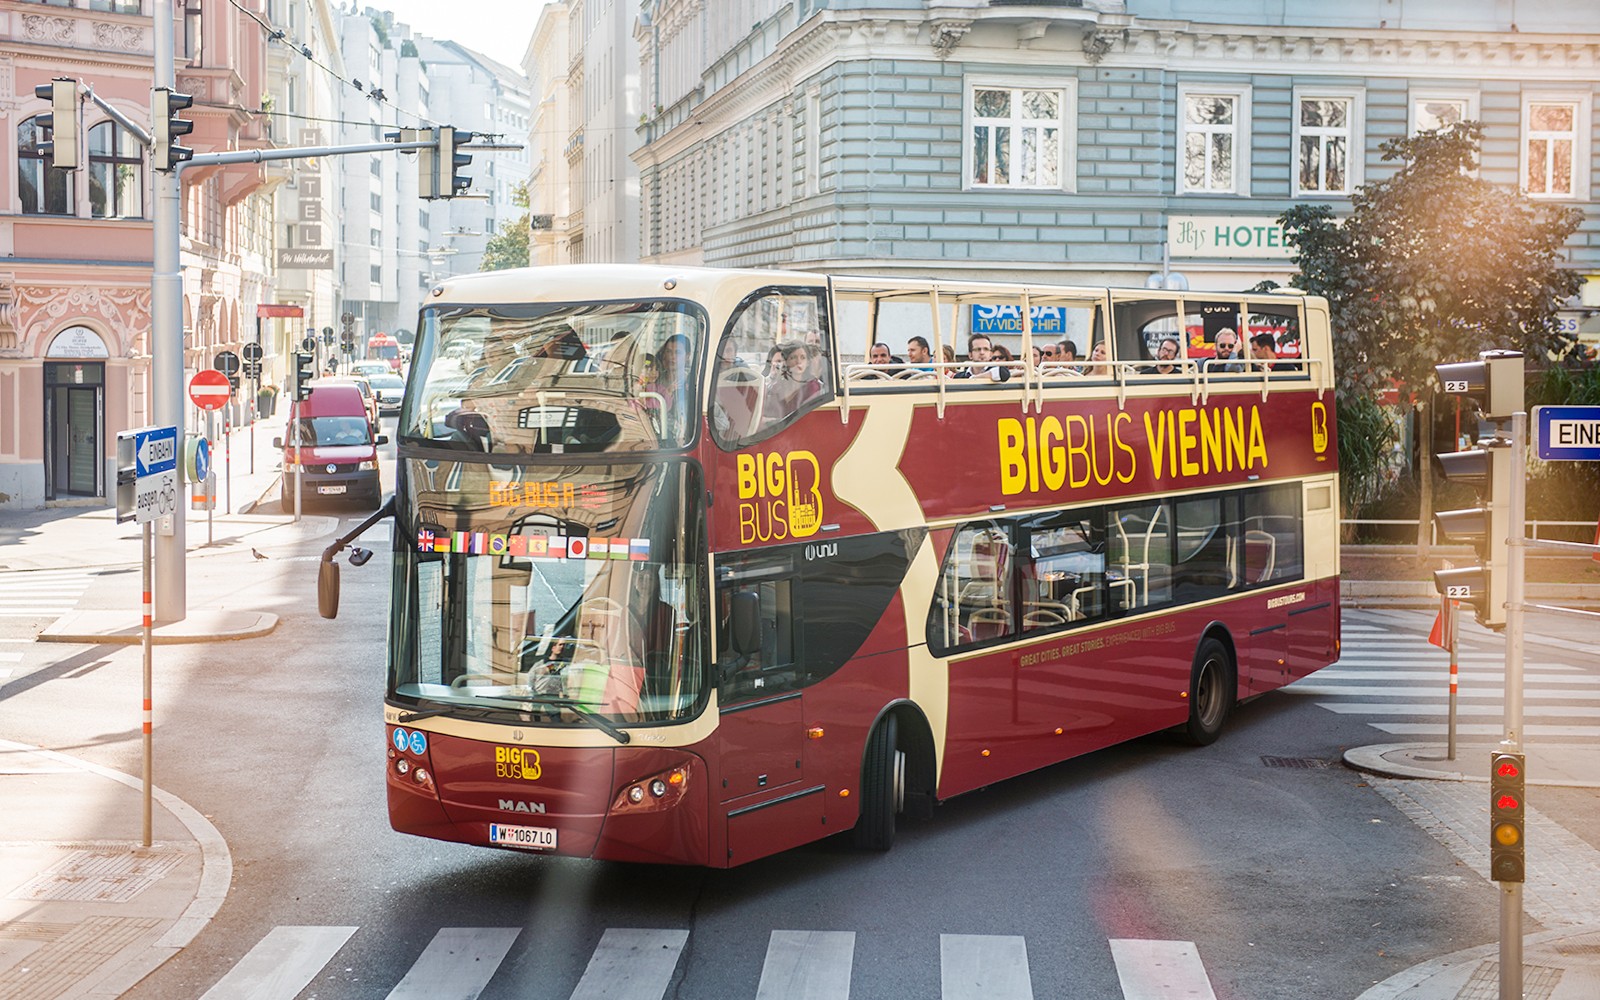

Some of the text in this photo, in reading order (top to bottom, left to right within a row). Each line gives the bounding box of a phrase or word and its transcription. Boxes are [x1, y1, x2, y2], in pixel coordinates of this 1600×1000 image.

[1143, 404, 1268, 481] VIENNA
[737, 451, 785, 500] BIG
[489, 481, 521, 507] BIG
[524, 482, 560, 509] BUS
[740, 500, 788, 545] BUS
[1020, 652, 1040, 667] GREAT
[1062, 643, 1080, 657] GREAT
[495, 746, 520, 764] BIG
[496, 763, 522, 779] BUS
[498, 799, 546, 814] MAN
